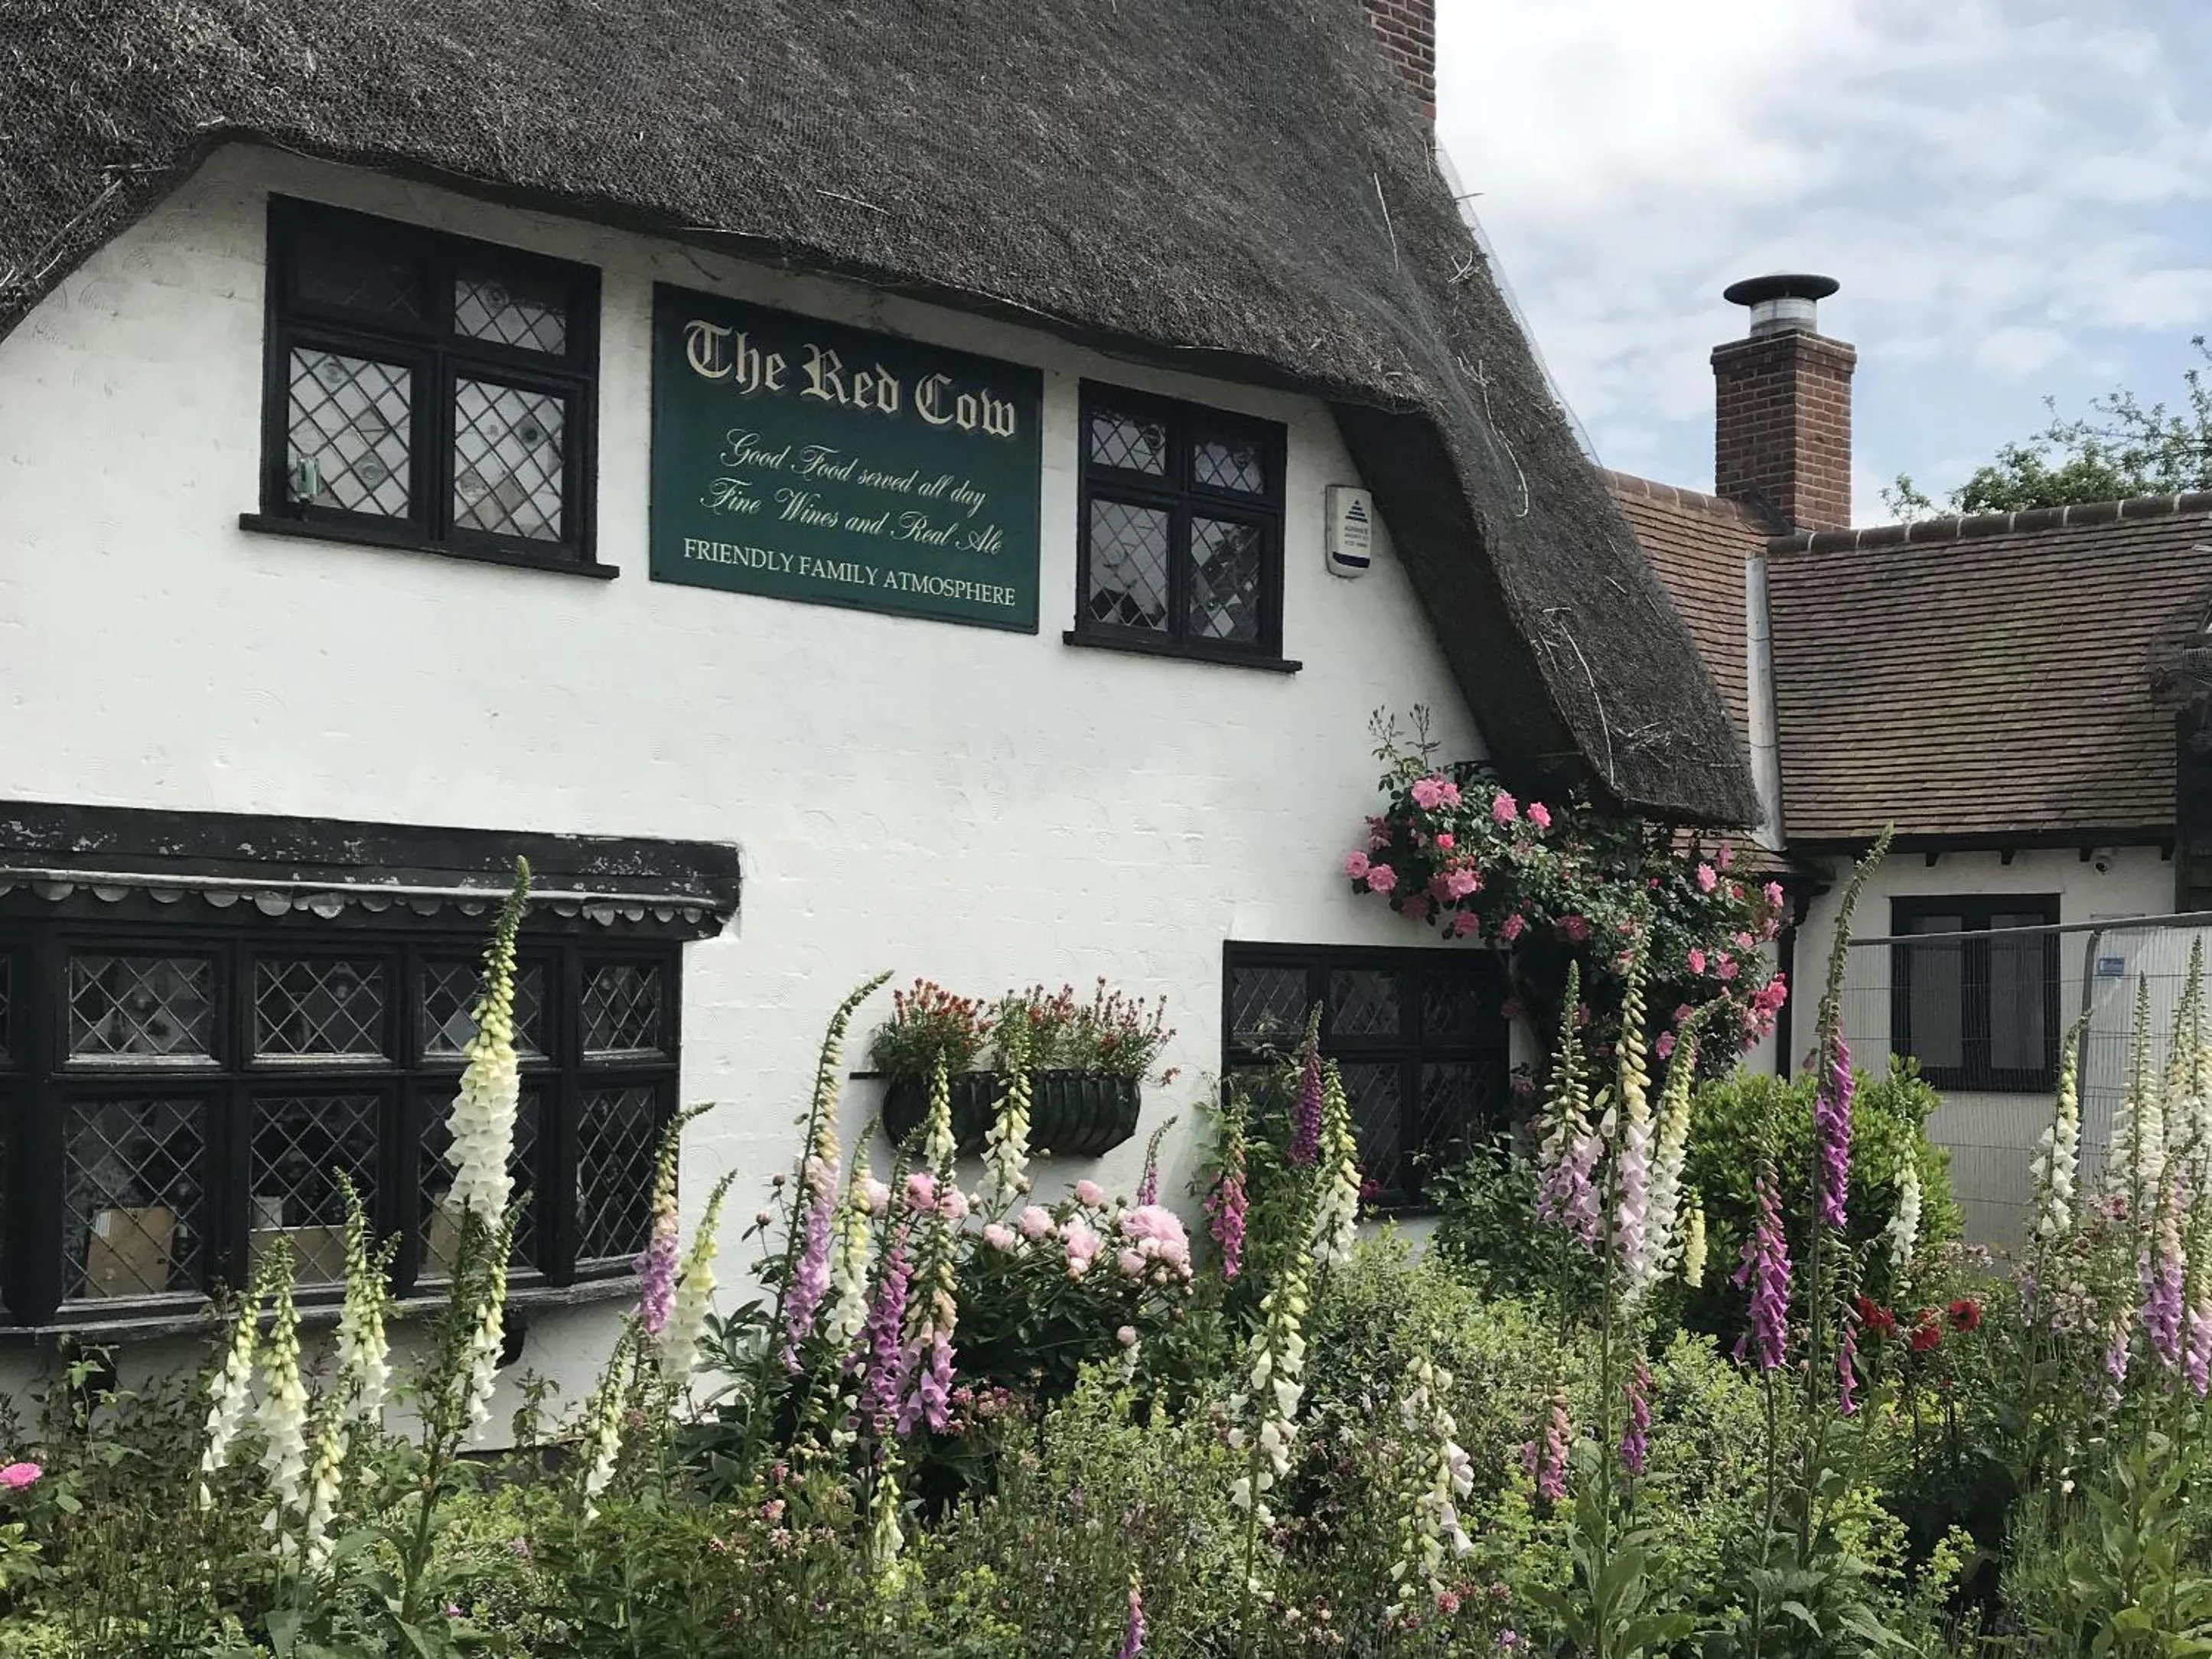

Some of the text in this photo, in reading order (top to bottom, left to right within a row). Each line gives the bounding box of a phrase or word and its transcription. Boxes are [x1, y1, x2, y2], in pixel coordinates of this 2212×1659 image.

[684, 319, 1016, 438] The Red Cow
[699, 476, 1002, 556] Fine Wines and Real Ale
[721, 429, 986, 519] Good Food served all day
[683, 537, 1016, 607] FRIENDLY FAMILY ATMOSPHERE
